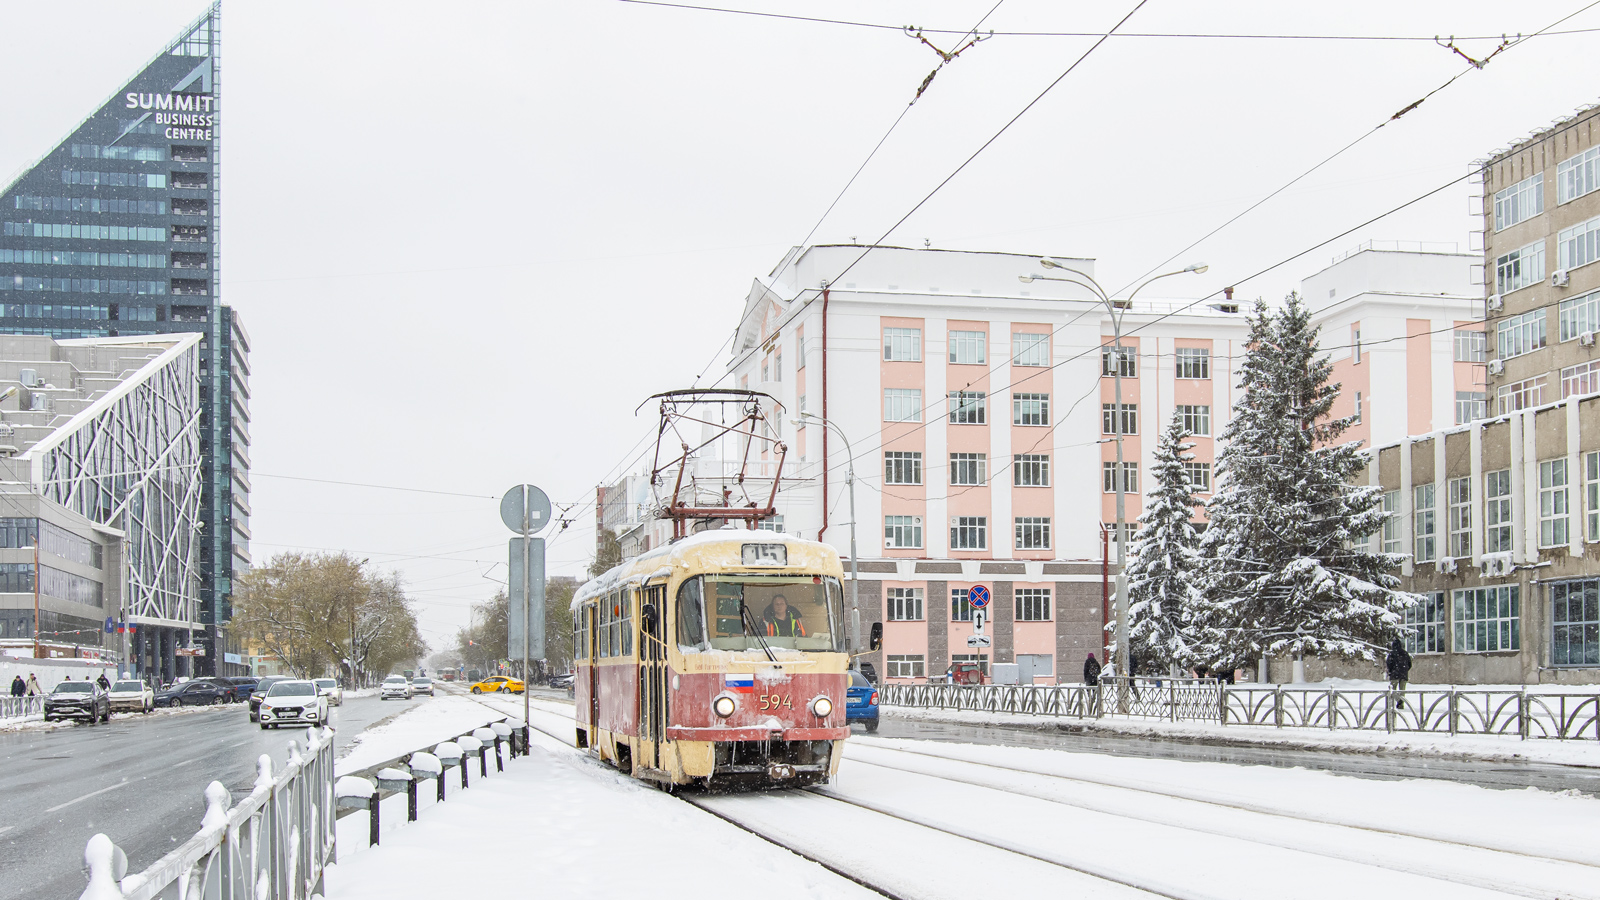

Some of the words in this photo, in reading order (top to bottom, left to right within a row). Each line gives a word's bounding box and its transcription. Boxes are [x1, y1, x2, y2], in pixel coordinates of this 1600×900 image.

[126, 92, 213, 112] SUMMIT
[155, 113, 213, 126] BUSINESS
[165, 128, 212, 140] CENTRE
[760, 694, 793, 711] 594
